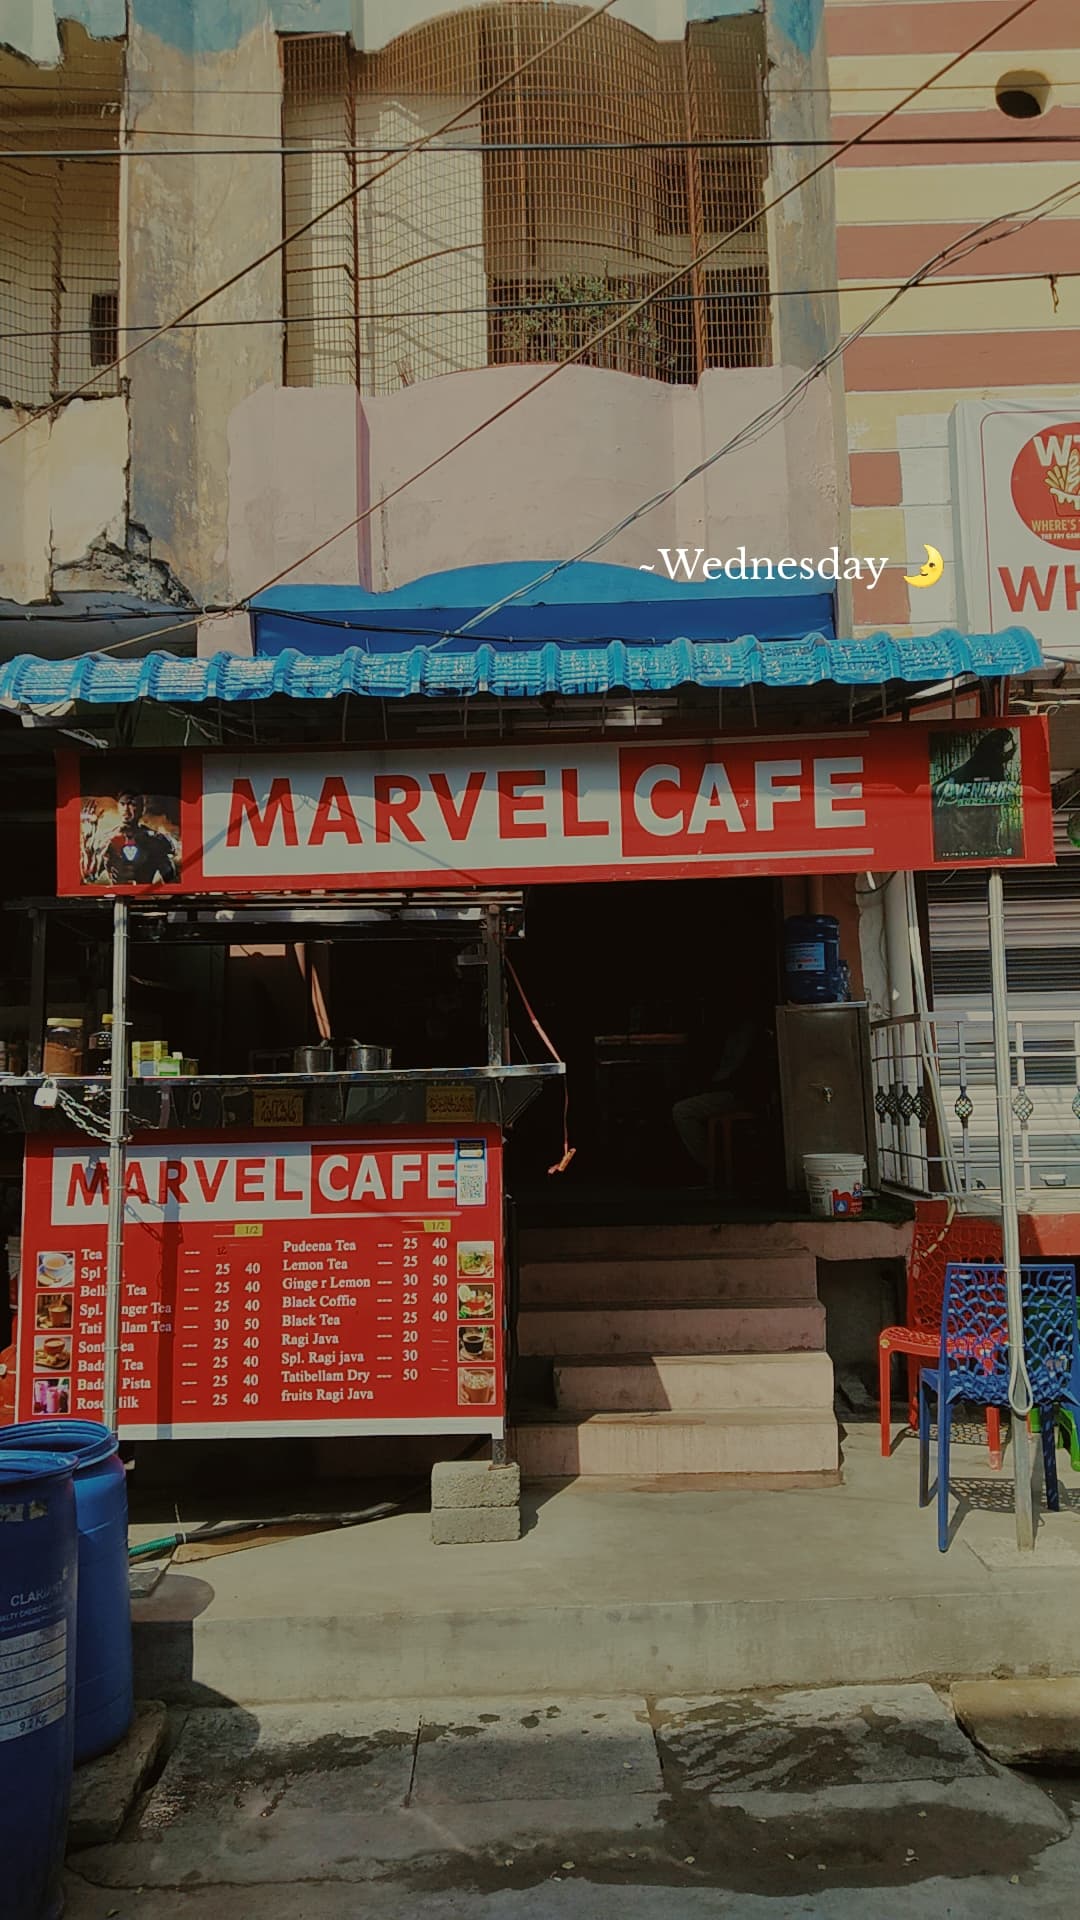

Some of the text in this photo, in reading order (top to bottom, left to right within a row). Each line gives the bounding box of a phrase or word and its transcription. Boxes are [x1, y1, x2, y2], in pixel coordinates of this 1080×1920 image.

[1031, 519, 1077, 532] WHERE'S
[225, 756, 867, 848] MARVEL CAFE
[66, 1153, 457, 1207] MARVEL CAFE
[283, 1236, 448, 1253] Pudeena Tea 25 40
[81, 1248, 103, 1261] Tea
[283, 1254, 448, 1271] Lemon Tea 25 40
[81, 1266, 101, 1281] Spl
[215, 1263, 231, 1276] 25
[245, 1262, 261, 1275] 40
[80, 1280, 261, 1298] Bell Tea 25 40
[330, 1275, 371, 1289] Lemon
[403, 1273, 419, 1286] 30
[432, 1273, 448, 1287] 50
[79, 1299, 260, 1318] Spl. nger Tea 25 40
[282, 1295, 317, 1309] Black
[402, 1292, 418, 1305] 25
[432, 1291, 448, 1305] 40
[120, 1320, 148, 1334] llam
[150, 1320, 172, 1333] Tea
[214, 1318, 230, 1331] 30
[244, 1317, 260, 1331] 50
[281, 1310, 448, 1327] Black Tea 25 40
[78, 1341, 107, 1354] Sont
[213, 1337, 229, 1350] 25
[243, 1336, 260, 1349] 40
[281, 1330, 419, 1348] Ragi Java 20
[77, 1355, 259, 1373] Bad Tea 25 40
[281, 1349, 419, 1367] Spl. Ragi java 30
[77, 1373, 259, 1391] Bad Pista 25 40
[281, 1368, 419, 1384] Tatibellam Dry 50
[118, 1395, 139, 1409] ilk
[212, 1393, 228, 1406] 25
[243, 1392, 259, 1405] 40
[281, 1387, 374, 1404] fruits Ragi Java
